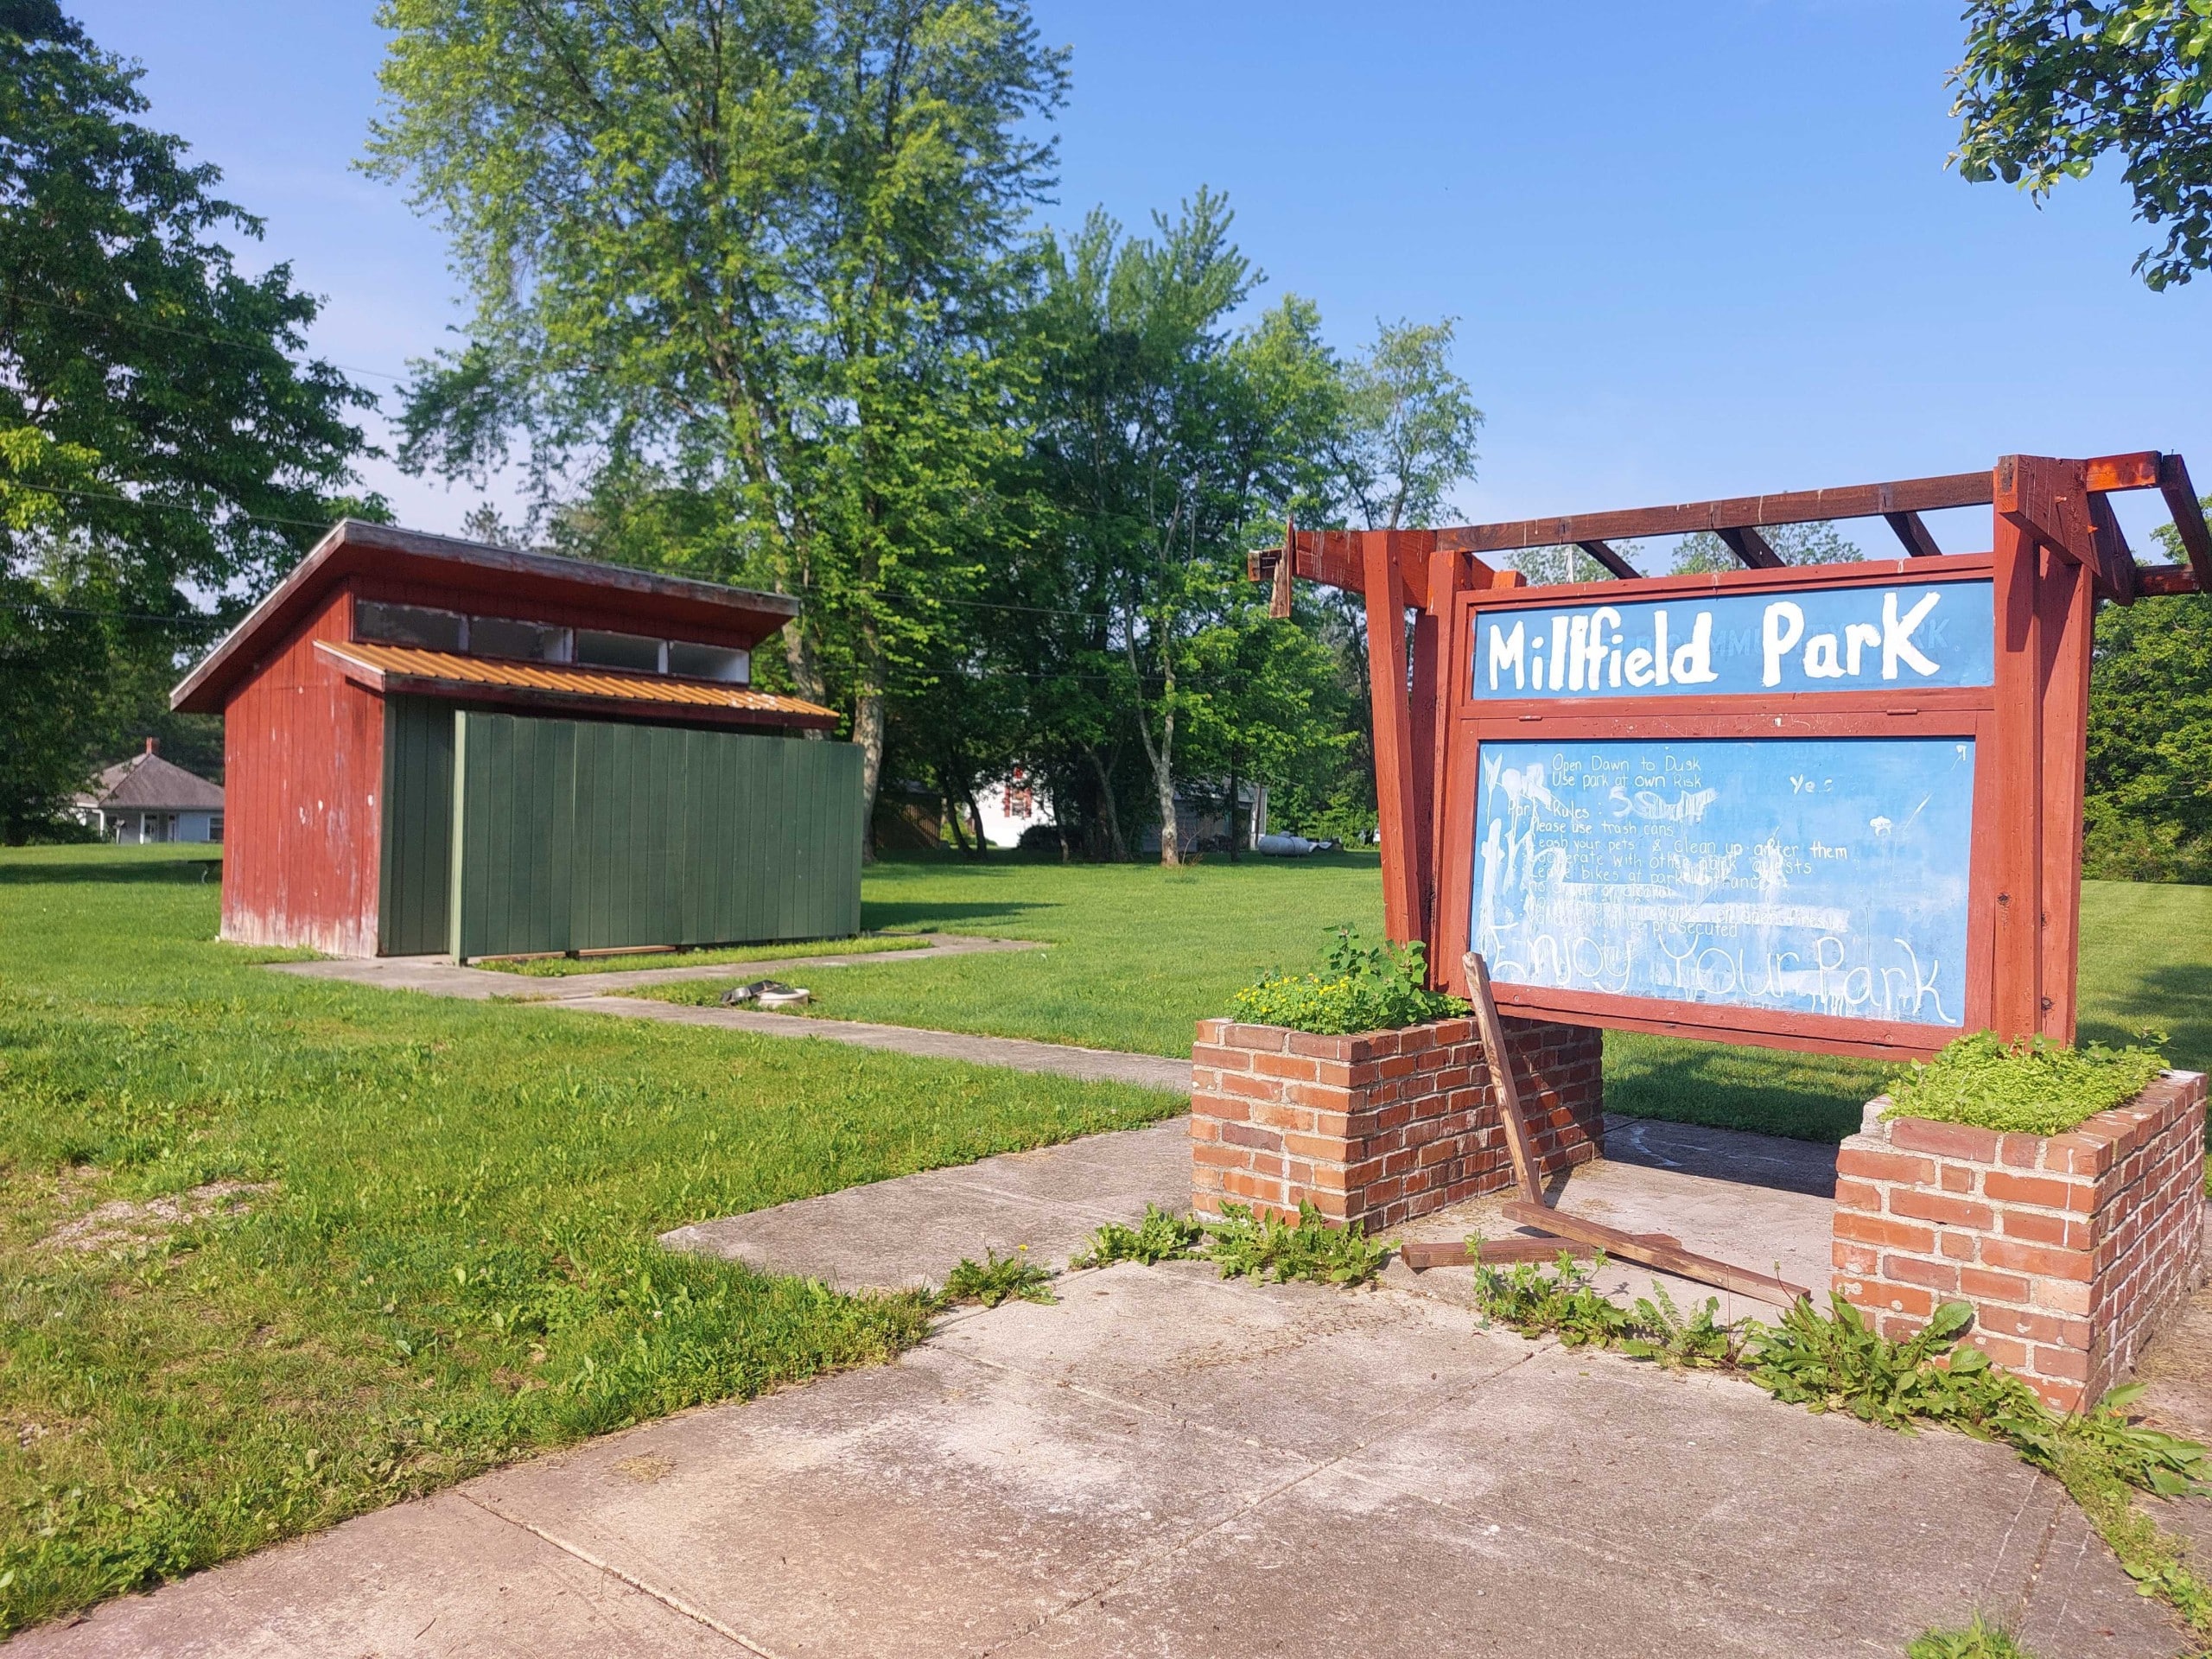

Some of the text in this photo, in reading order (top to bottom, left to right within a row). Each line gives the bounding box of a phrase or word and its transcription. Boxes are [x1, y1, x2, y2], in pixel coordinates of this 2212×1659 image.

[1490, 607, 1719, 690] Millfield
[1552, 753, 1702, 776] Open Dawn to Dusk
[1552, 772, 1702, 791] Use park at own Risk
[1531, 817, 1675, 837] Please use trash cans
[1573, 840, 1602, 852] your
[1608, 838, 1636, 854] pets
[1809, 840, 1848, 861] them
[1612, 852, 1643, 868] with
[1581, 865, 1619, 881] bikes
[1628, 868, 1643, 882] at
[1649, 871, 1684, 887] park
[1651, 920, 1738, 938] prosecuted
[1489, 921, 1956, 1024] Enjoy Your Park
